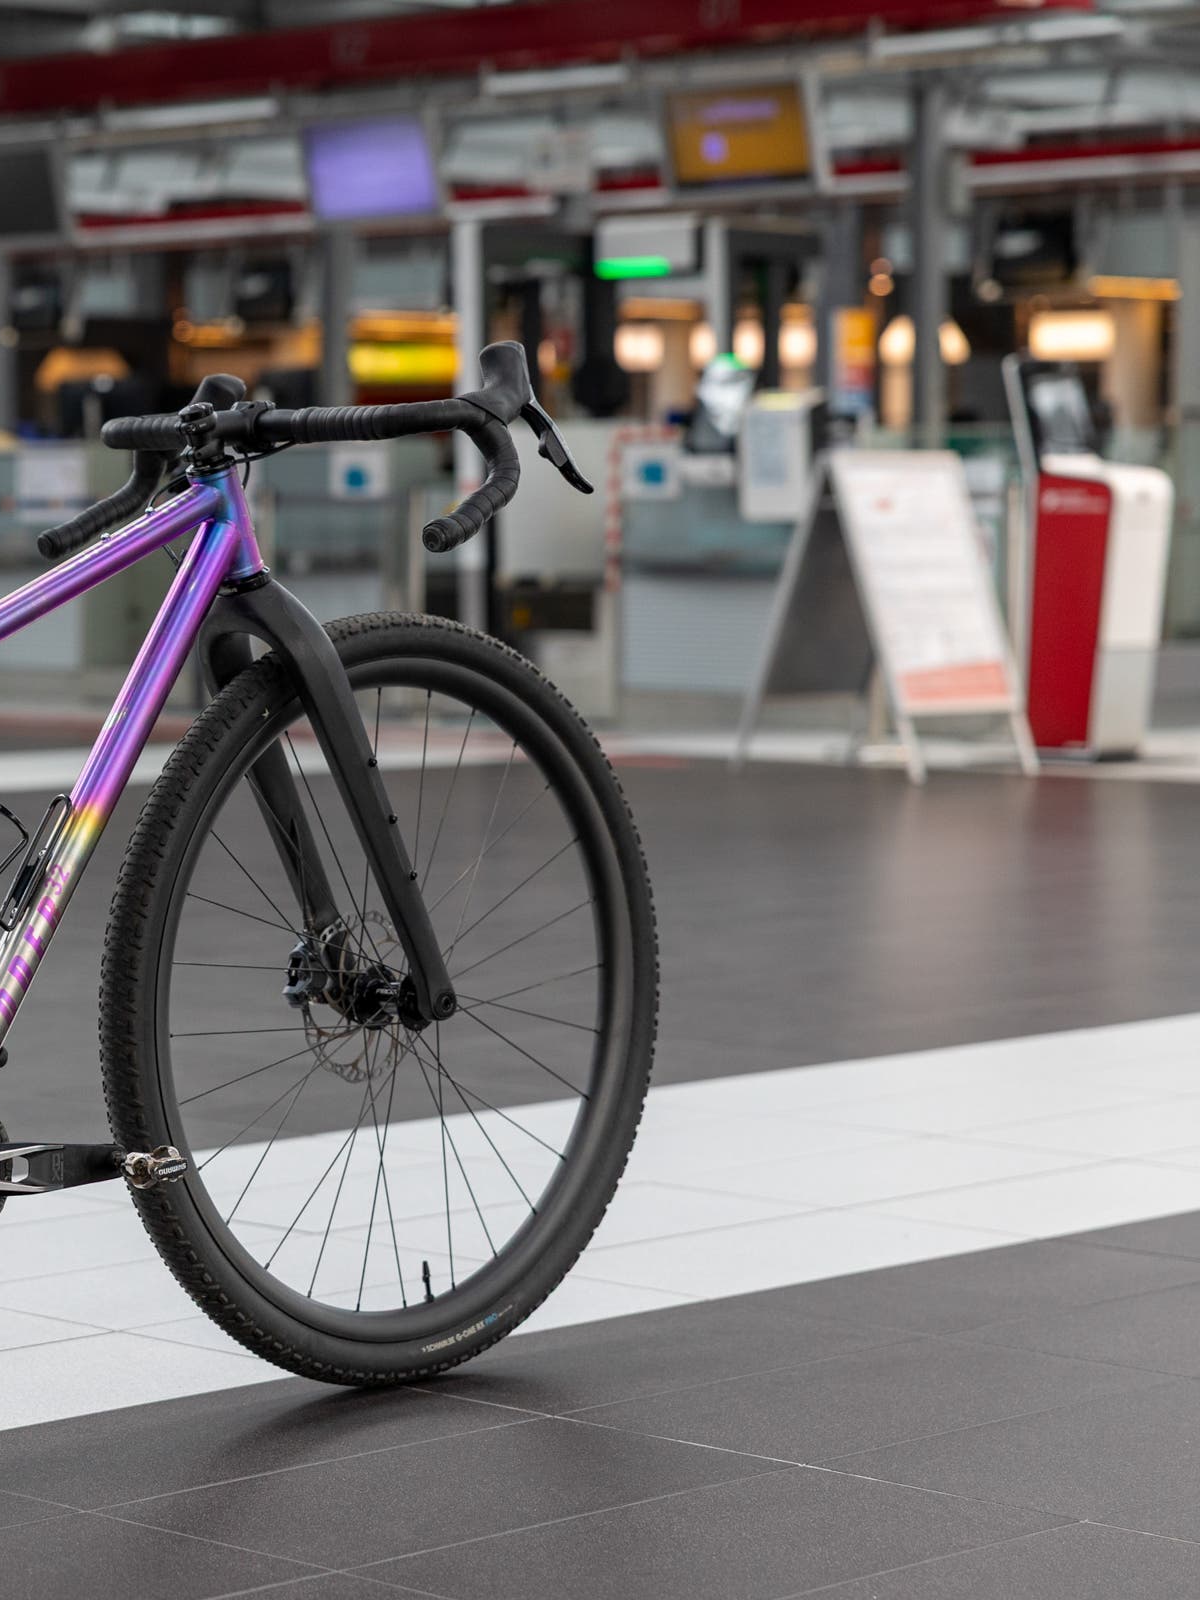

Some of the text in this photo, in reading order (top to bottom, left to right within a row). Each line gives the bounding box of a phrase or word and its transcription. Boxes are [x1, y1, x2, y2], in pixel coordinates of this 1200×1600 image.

[44, 864, 70, 896] 32
[158, 1162, 187, 1175] SHIMANO
[455, 1325, 477, 1342] G-ONE
[475, 1320, 485, 1330] RX
[485, 1312, 498, 1326] PRO
